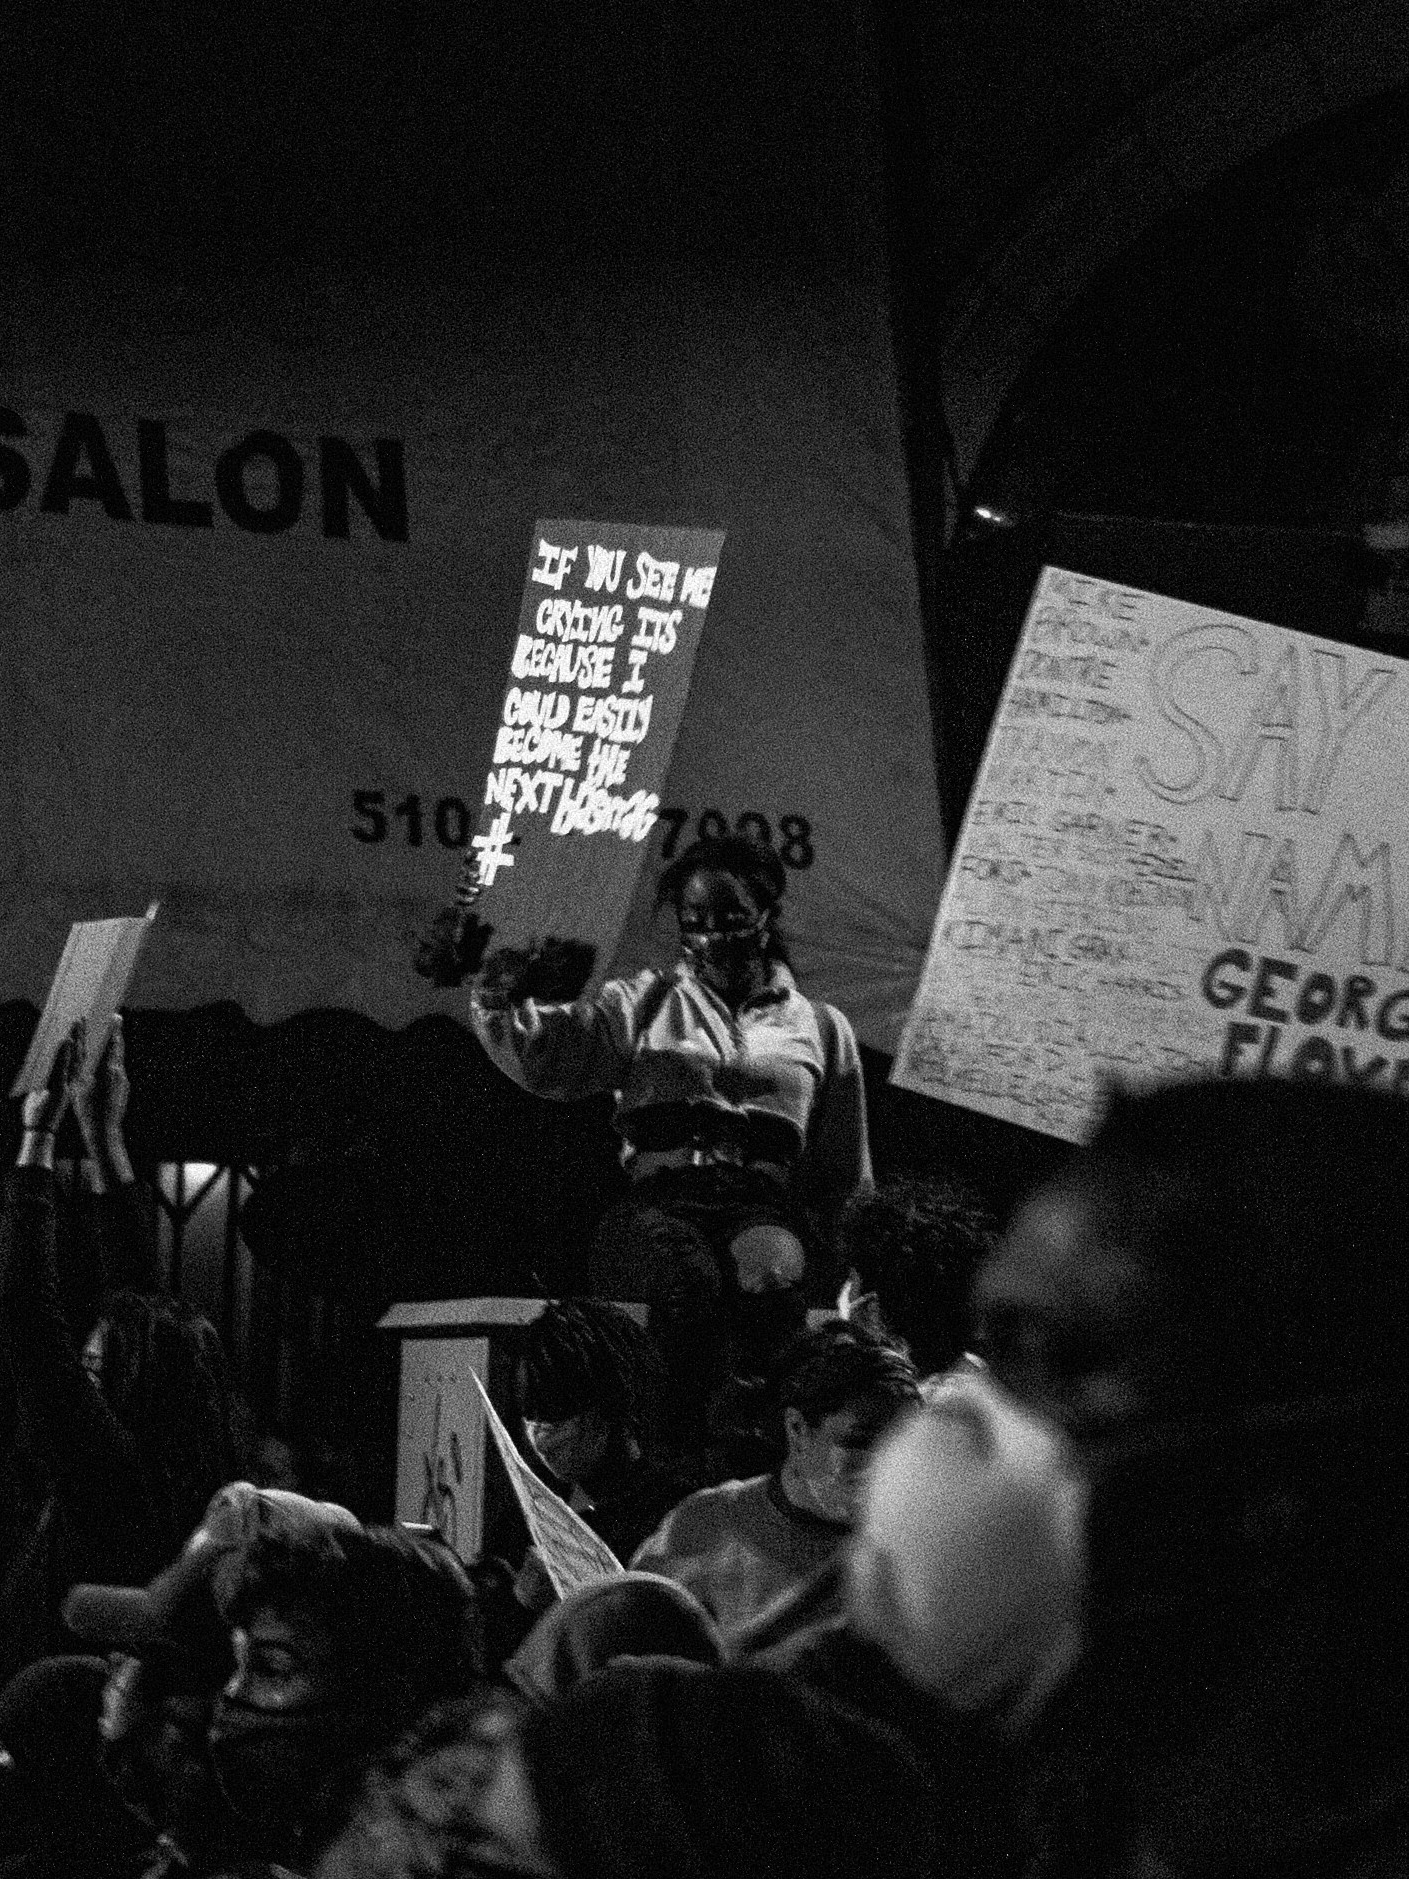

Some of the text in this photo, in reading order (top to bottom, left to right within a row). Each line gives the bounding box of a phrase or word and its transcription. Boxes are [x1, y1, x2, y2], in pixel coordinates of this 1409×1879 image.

[531, 538, 718, 609] IF YOU SEE ME
[536, 599, 683, 654] CRYING ITS
[510, 634, 648, 693] BECAUSE I
[503, 687, 653, 744] COULD EASILY
[1135, 622, 1397, 816] SAY
[492, 725, 583, 771] BECOME
[352, 788, 471, 850] 510
[484, 767, 564, 814] NEXT
[1191, 828, 1409, 975] NAM
[1202, 948, 1409, 1042] GEORG
[1219, 1020, 1409, 1096] FLOY
